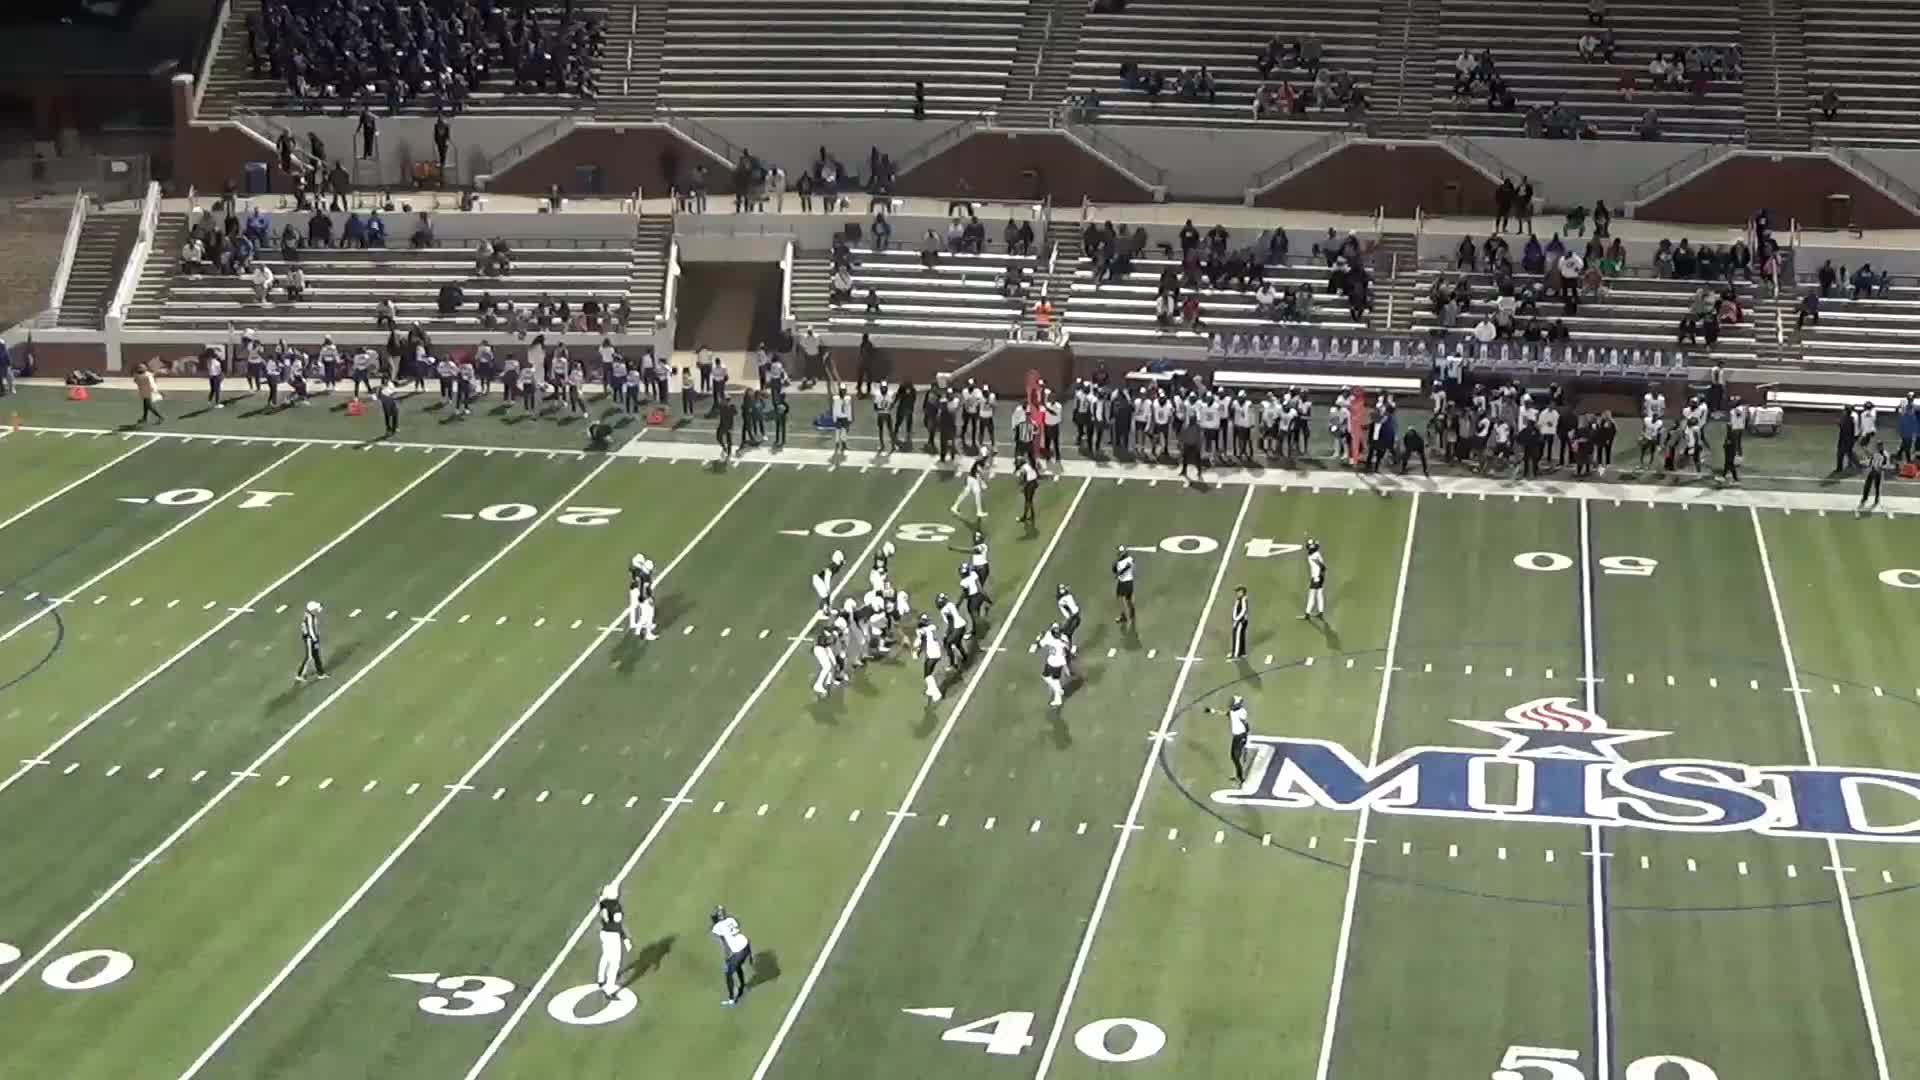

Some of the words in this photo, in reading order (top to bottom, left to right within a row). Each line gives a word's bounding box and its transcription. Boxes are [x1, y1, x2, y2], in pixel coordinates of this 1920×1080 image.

[154, 489, 293, 508] 10
[478, 503, 622, 526] 20
[814, 518, 956, 542] 30
[1159, 535, 1304, 558] 40
[1513, 551, 1658, 576] 50
[1210, 735, 1920, 844] MISD
[418, 975, 638, 1025] 30
[941, 1011, 1166, 1063] 40
[1491, 1045, 1720, 1080] 50
